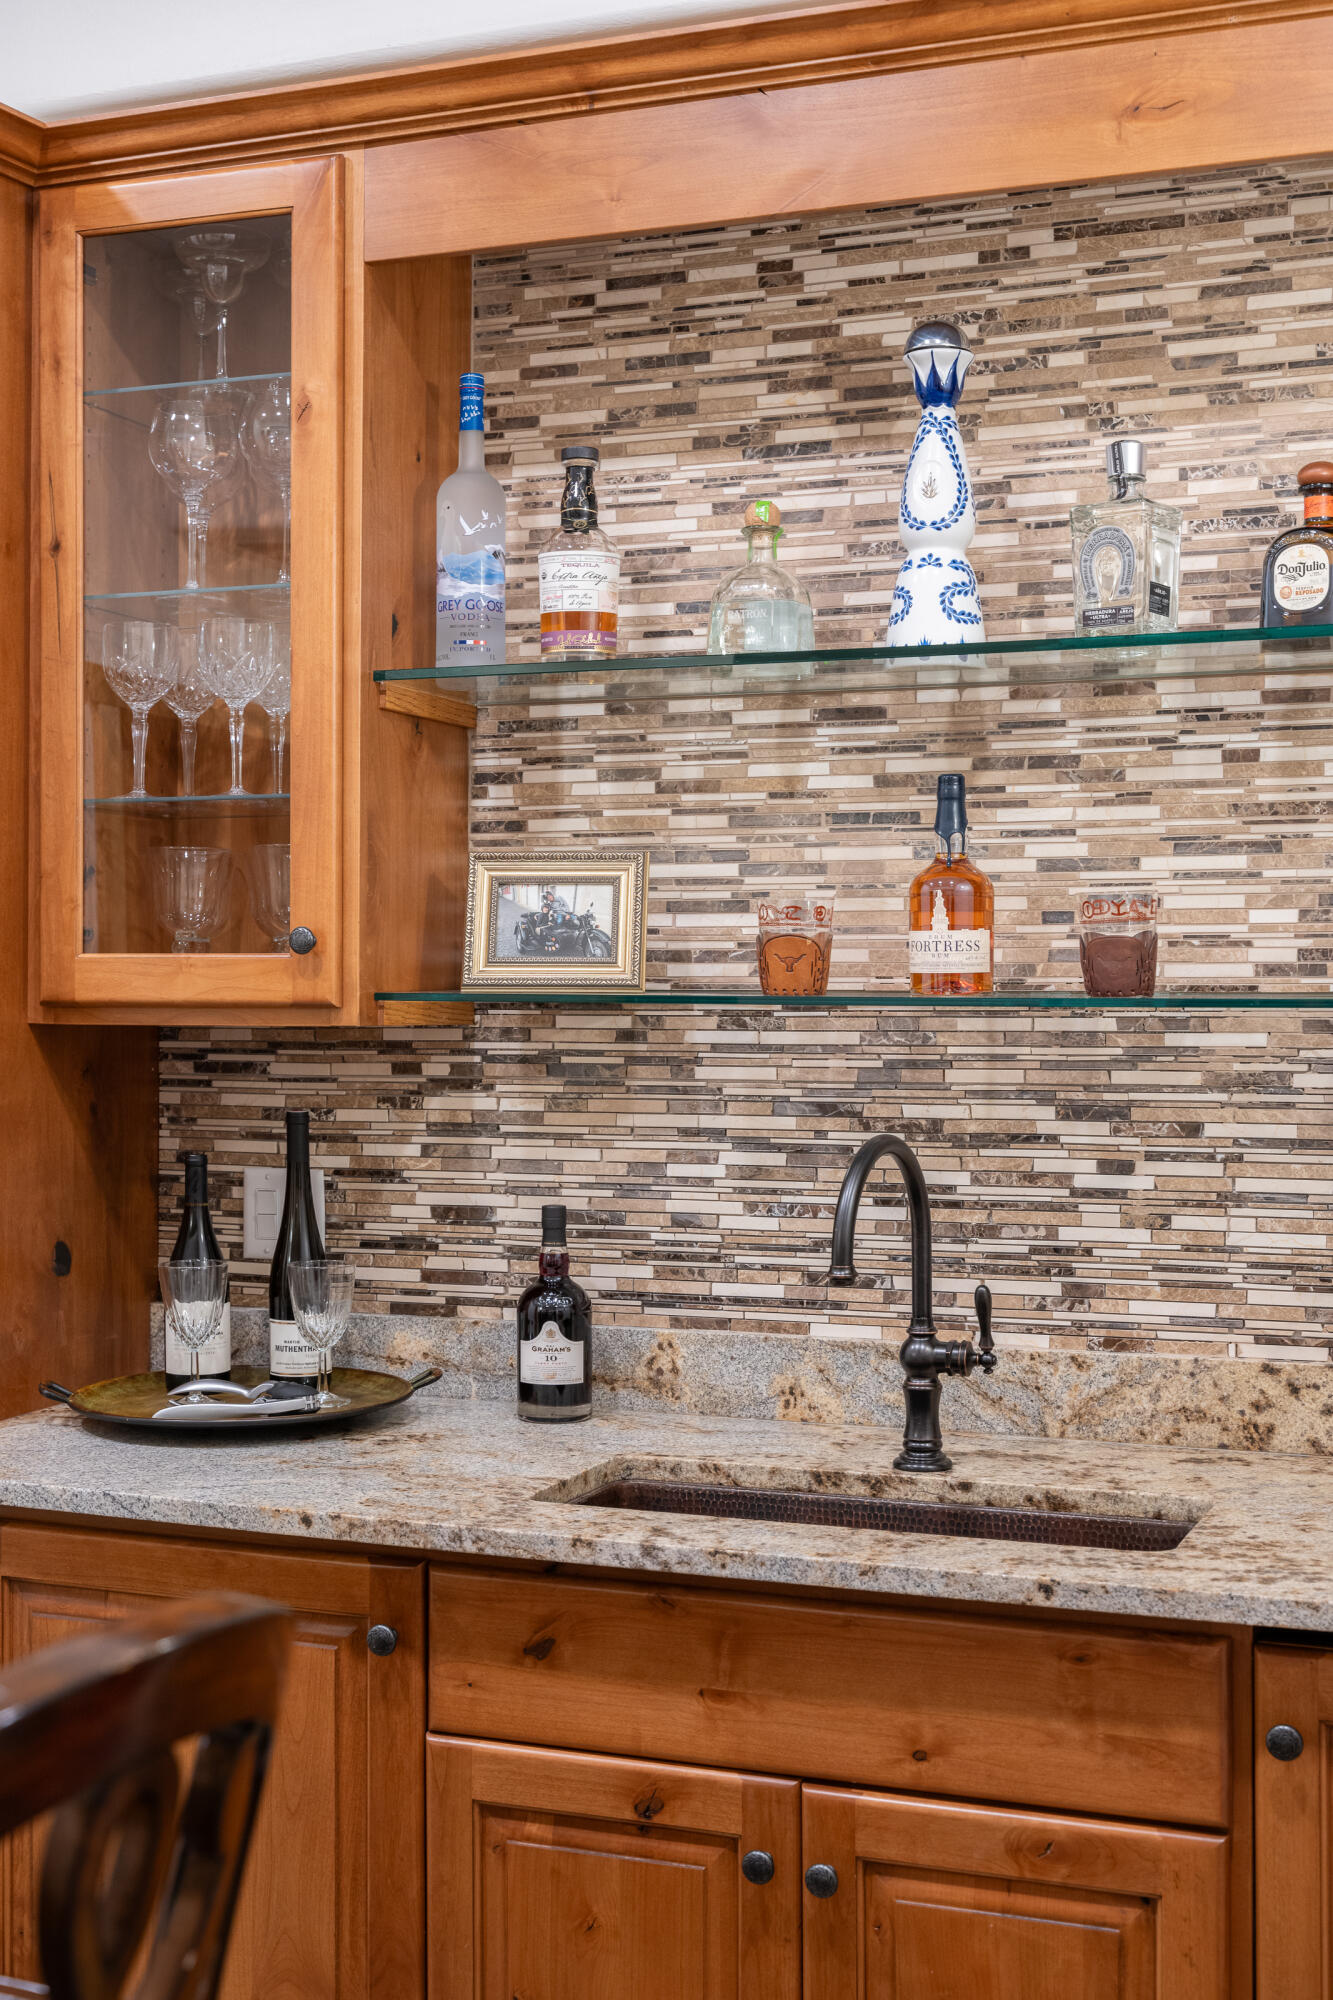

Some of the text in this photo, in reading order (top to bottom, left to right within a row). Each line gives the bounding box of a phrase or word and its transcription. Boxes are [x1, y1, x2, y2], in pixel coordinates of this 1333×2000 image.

[1294, 587, 1325, 597] REPOSADO
[437, 598, 504, 614] GREY GOOSE
[911, 940, 980, 952] FORTRESS
